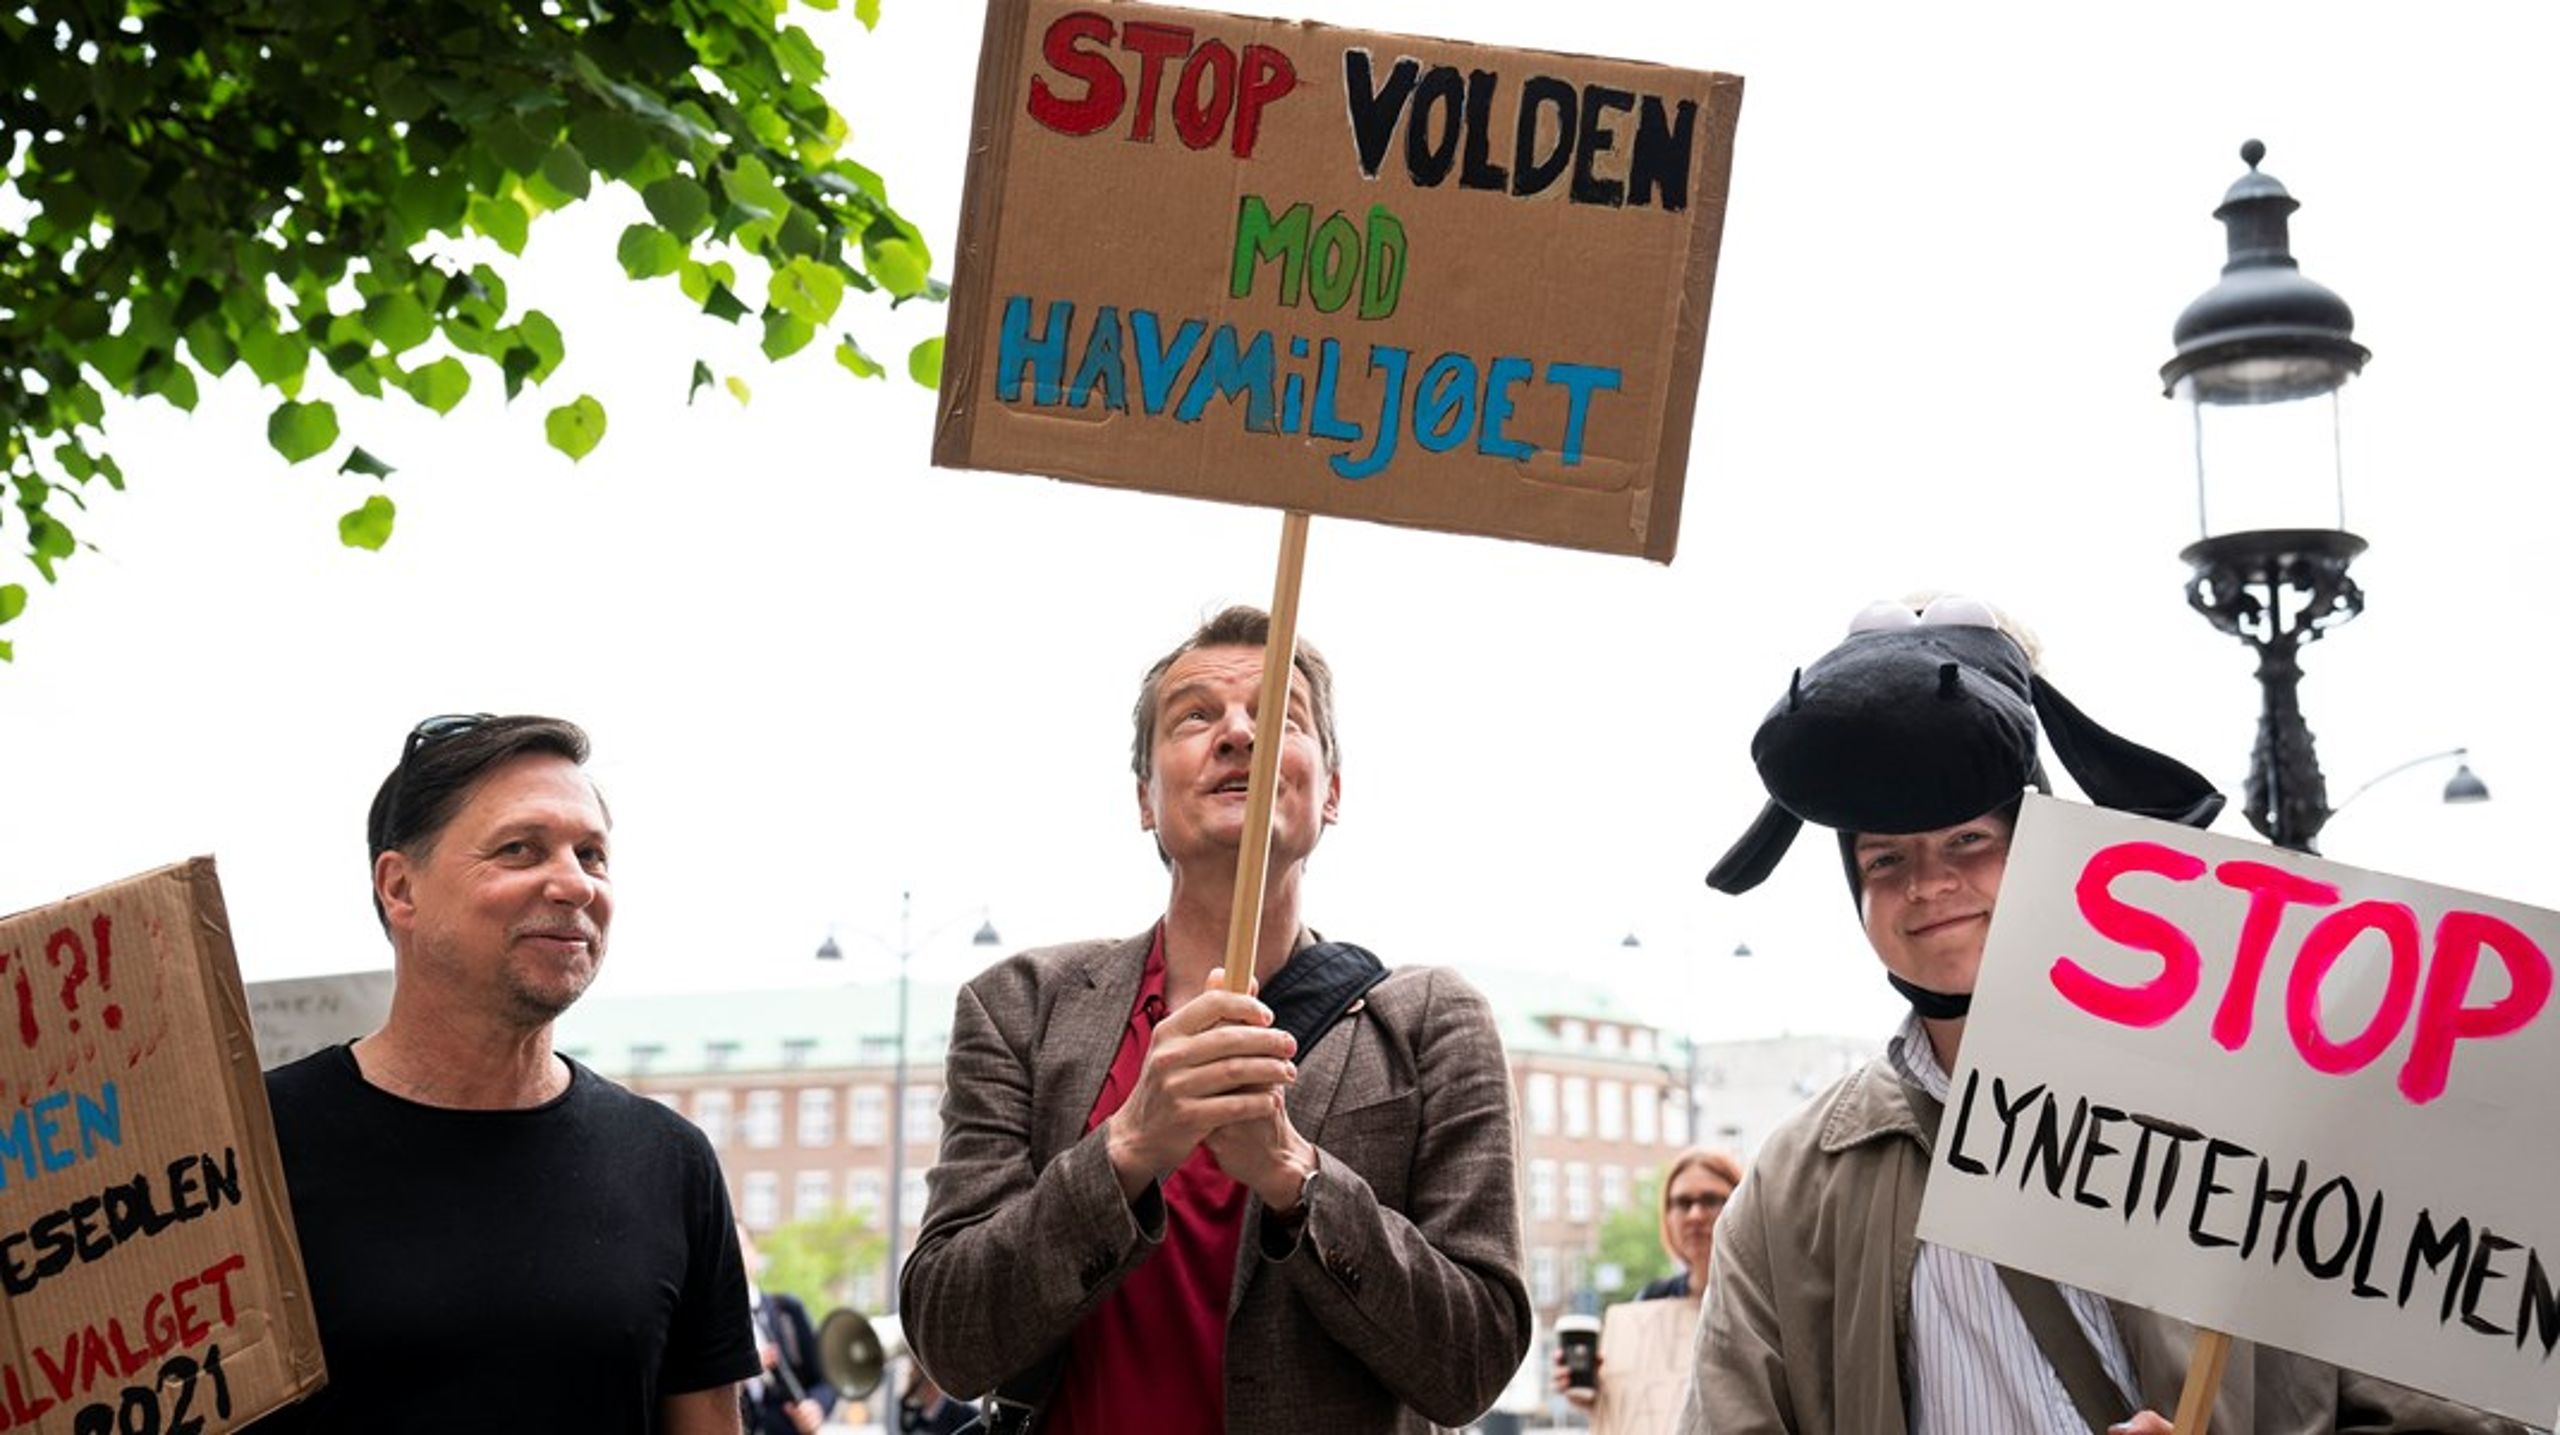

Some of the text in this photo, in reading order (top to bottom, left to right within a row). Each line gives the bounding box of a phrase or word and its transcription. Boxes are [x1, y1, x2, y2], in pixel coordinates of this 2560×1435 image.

[1028, 12, 1699, 213] STOP VOLDEN
[1229, 195, 1408, 320] MOD
[2049, 841, 2554, 1104] STOP
[1947, 1068, 2560, 1362] LYNETTEHOLMEN
[0, 1253, 246, 1433] LVALGET
